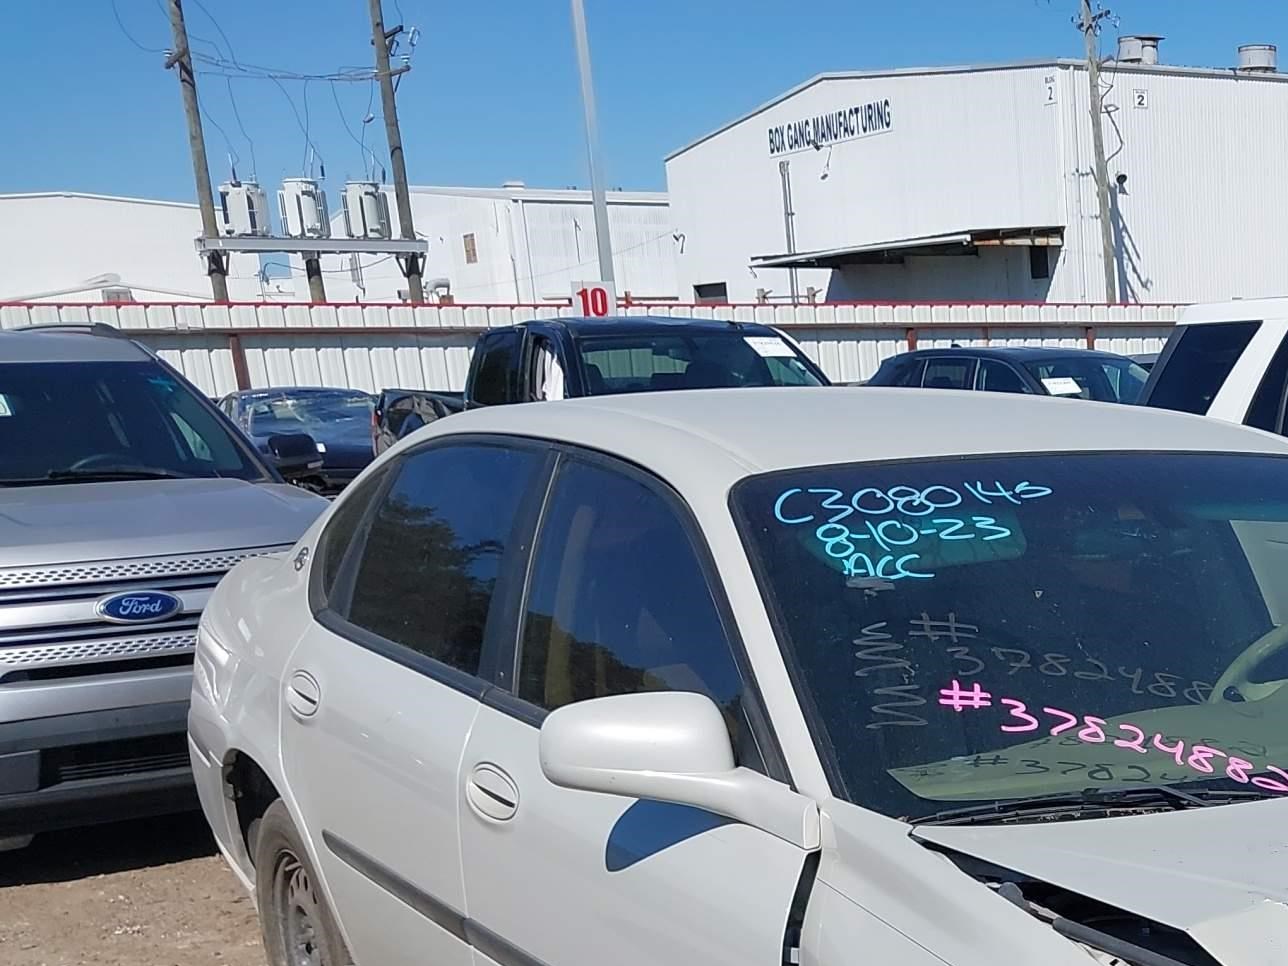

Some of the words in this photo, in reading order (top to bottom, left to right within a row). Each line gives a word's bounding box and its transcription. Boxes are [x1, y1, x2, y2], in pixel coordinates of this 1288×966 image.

[1136, 94, 1145, 106] 2
[769, 126, 786, 154] BOX
[787, 119, 811, 150] GANG
[812, 98, 891, 144] MANUFACTURING
[576, 287, 608, 318] 10
[815, 516, 1011, 558] 8-10-23
[119, 597, 162, 615] Ford
